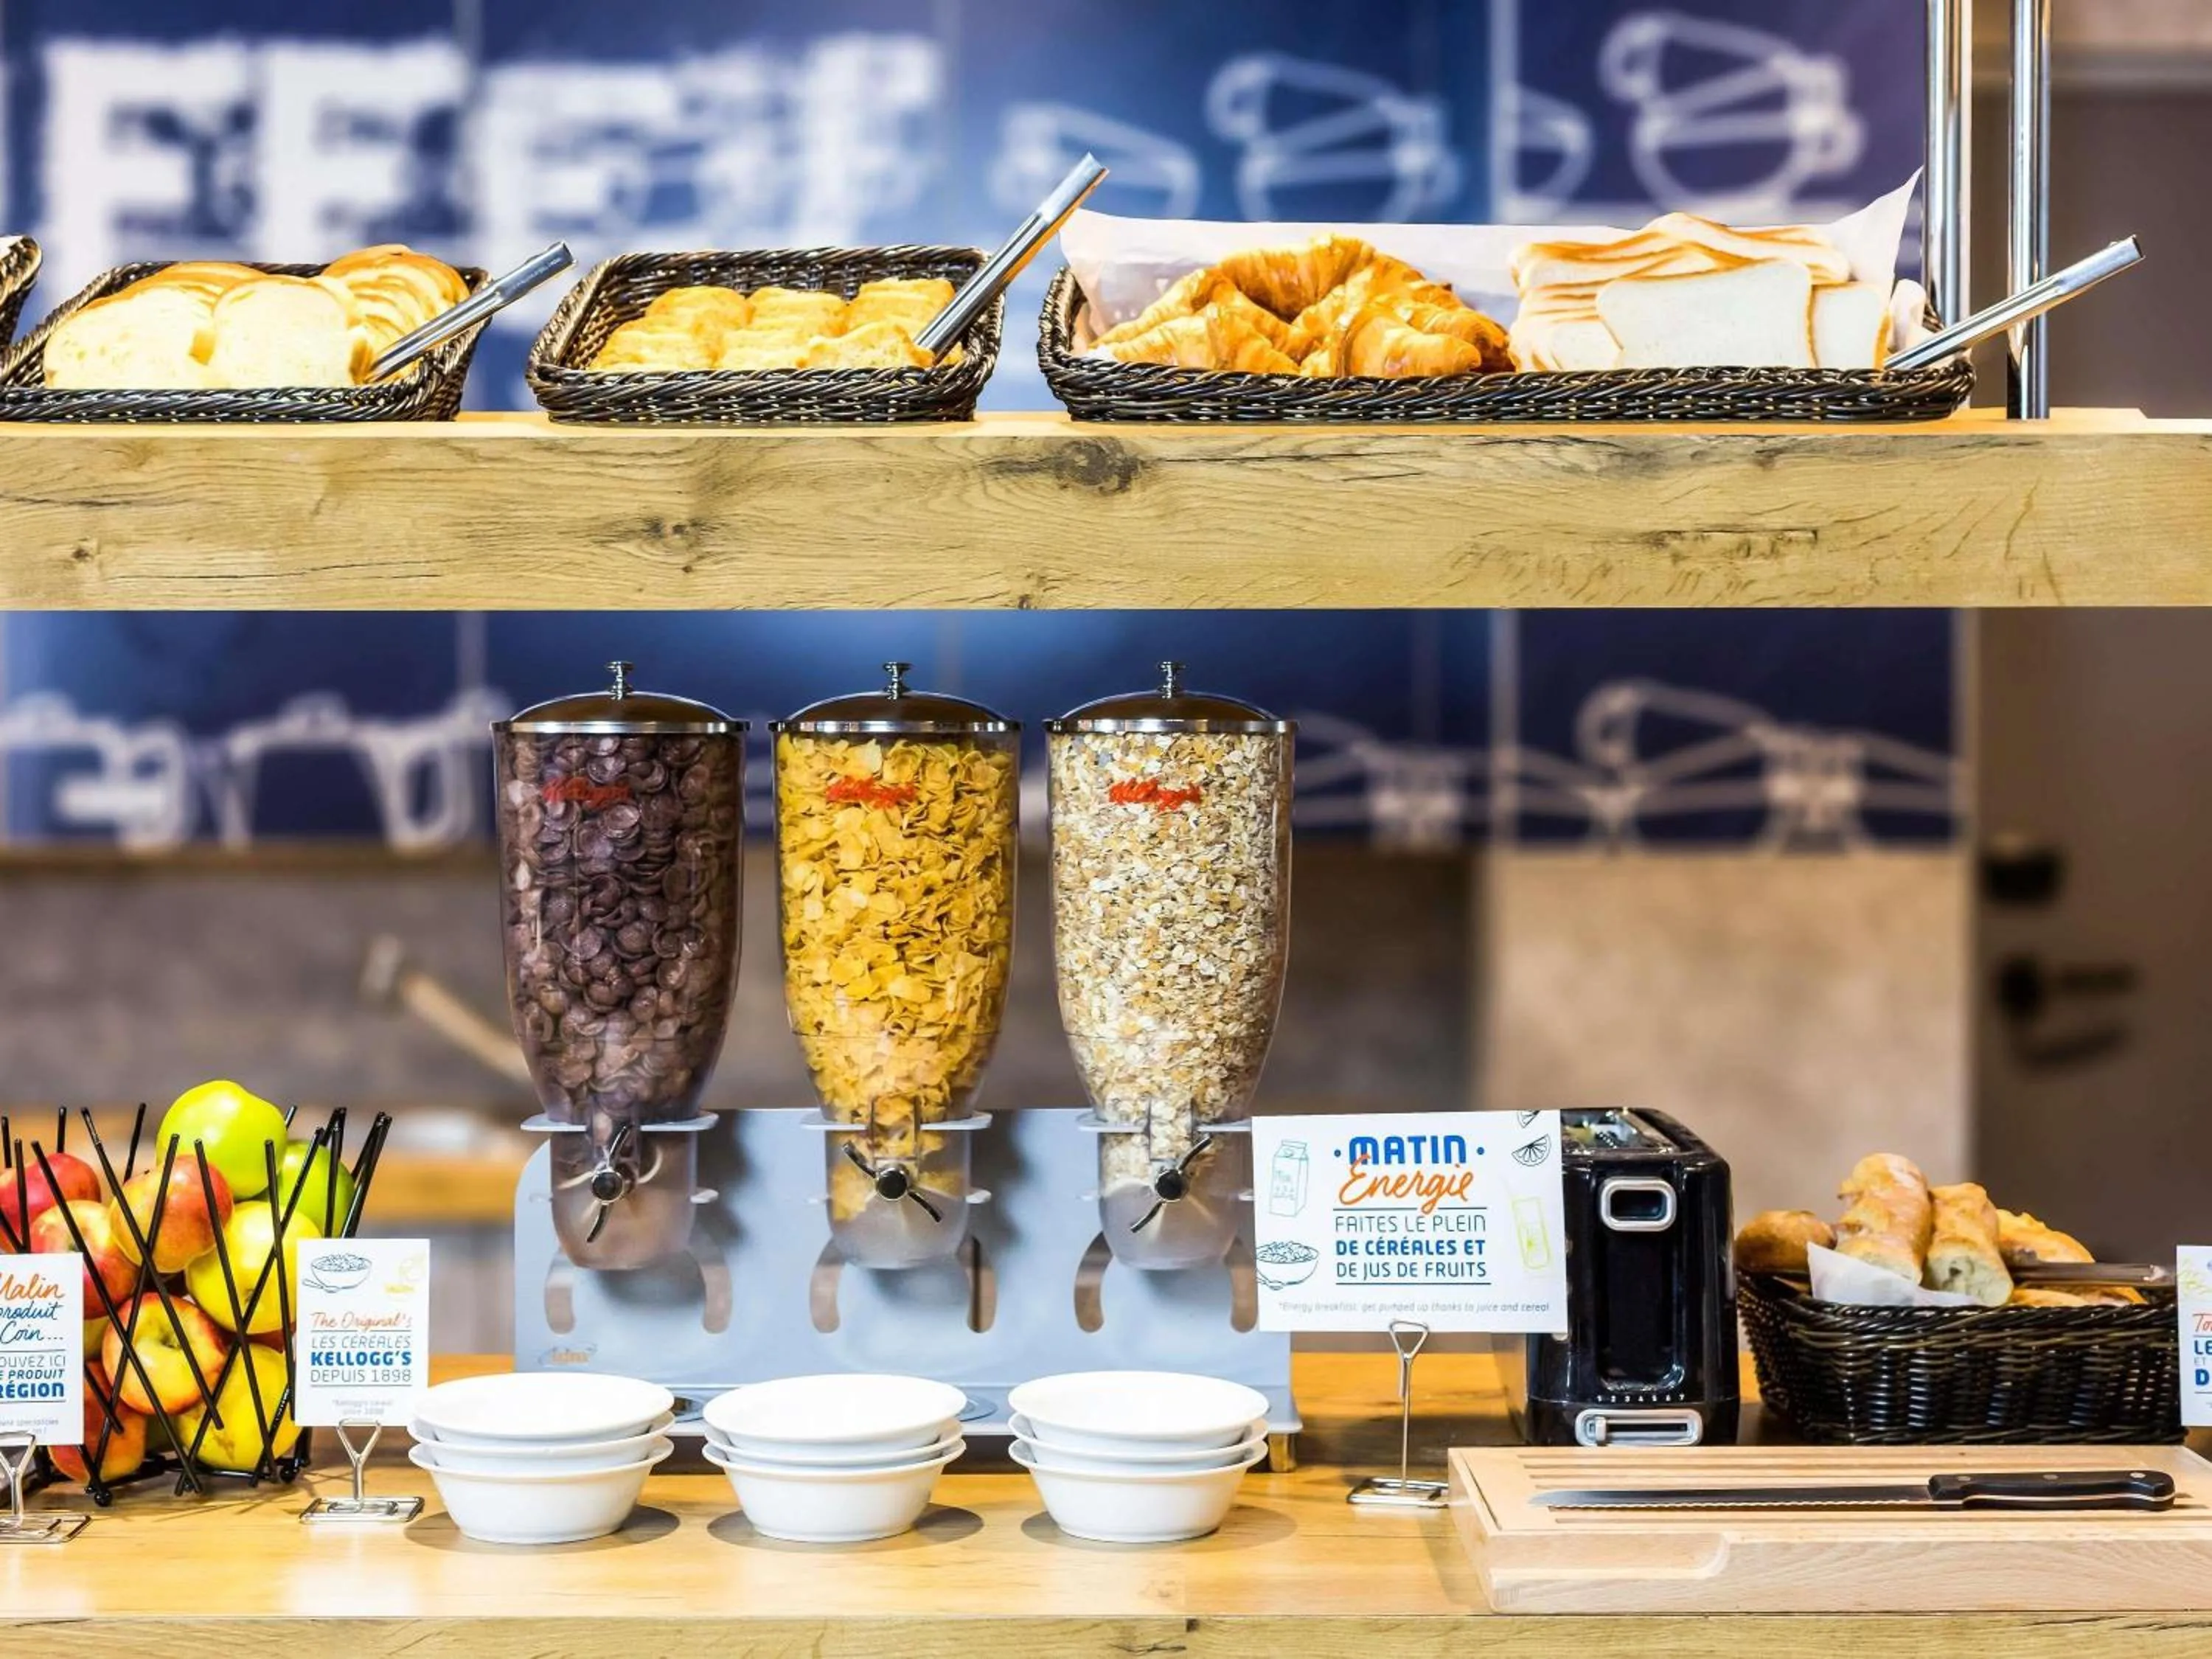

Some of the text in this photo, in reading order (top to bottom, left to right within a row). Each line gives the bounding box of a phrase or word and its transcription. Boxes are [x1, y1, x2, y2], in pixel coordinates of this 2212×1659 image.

[1349, 1135, 1467, 1165] MATIN
[1335, 1214, 1486, 1233] FAITES LE PLEIN
[1335, 1237, 1486, 1256] DE CÉRÉALES ET
[1336, 1261, 1487, 1281] DE JUS DE FRUITS
[1464, 1302, 1475, 1312] to
[1500, 1302, 1519, 1312] and
[1520, 1301, 1550, 1312] cereal
[310, 1312, 338, 1328] The
[311, 1335, 336, 1349] LES
[49, 1354, 66, 1366] ICI
[310, 1351, 412, 1366] KELLOGG'S
[8, 1368, 65, 1380] PRODUIT
[310, 1369, 411, 1382] DEPUIS 1898
